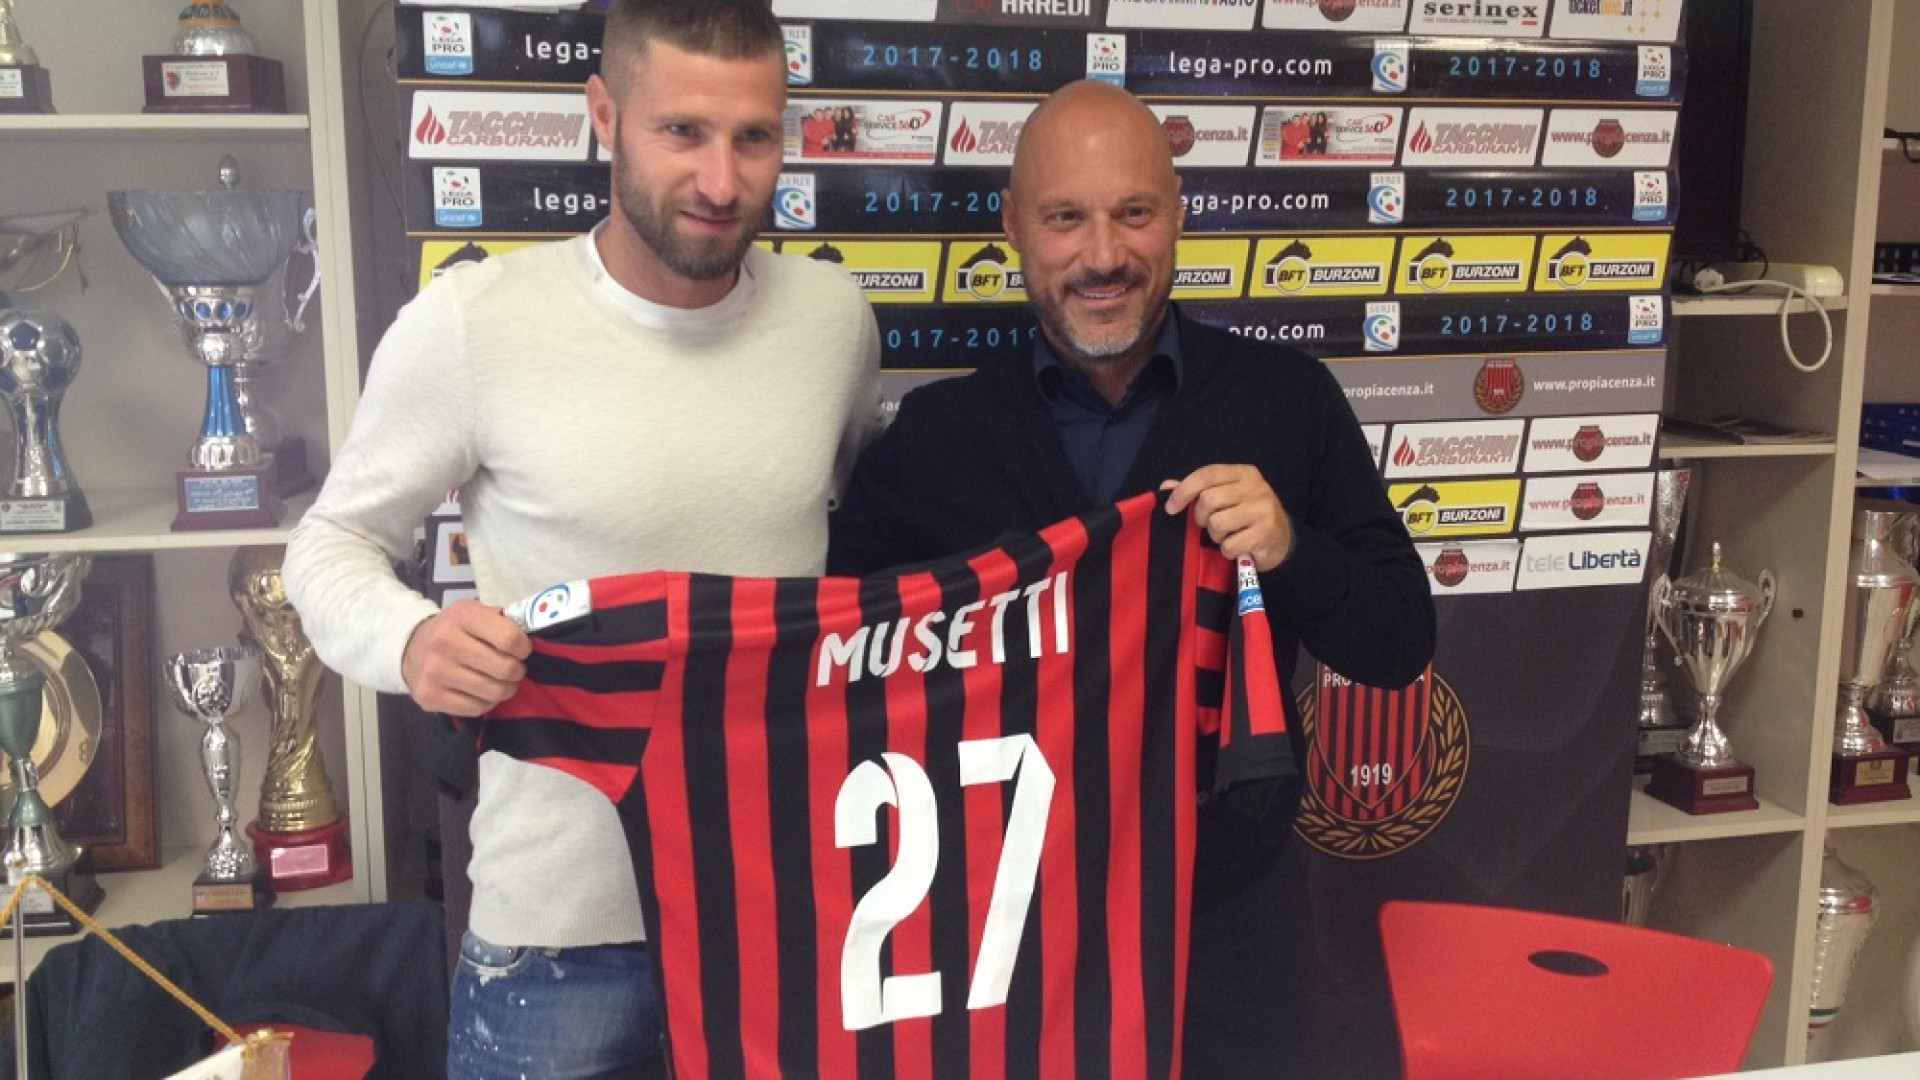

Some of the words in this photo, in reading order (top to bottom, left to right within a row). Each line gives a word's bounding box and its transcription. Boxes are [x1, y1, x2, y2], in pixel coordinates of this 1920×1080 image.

[1001, 0, 1090, 16] ARREDI
[1424, 0, 1539, 18] serinex
[432, 44, 465, 53] PRO
[863, 45, 1042, 71] 2017-2018
[1169, 51, 1332, 78] lega-pro.com
[1449, 55, 1601, 78] 2017-2018
[1643, 71, 1666, 79] PRO
[448, 111, 586, 136] TACCHINI
[446, 134, 579, 149] CARBURANTI
[1433, 124, 1538, 144] TACCHINI
[1431, 141, 1533, 154] CARBURANTI
[441, 197, 476, 207] PRO
[1446, 186, 1598, 207] 2017-2018
[1640, 196, 1663, 204] PRO
[1278, 269, 1305, 282] BFT
[1313, 267, 1376, 282] BURZONI
[1422, 267, 1447, 279] BFT
[1455, 264, 1516, 279] BURZONI
[1561, 264, 1585, 276] BFT
[1592, 263, 1651, 276] BURZONI
[972, 274, 999, 287] BFT
[1441, 313, 1593, 335] 2017-2018
[1533, 374, 1656, 394] www.propiacenza.it
[1417, 435, 1520, 454] TACCHINI
[1414, 451, 1514, 466] CARBURANTI
[1407, 510, 1434, 524] BFT
[1442, 508, 1501, 523] BURZONI
[1526, 553, 1566, 573] tele
[1569, 549, 1641, 571] Libertà
[816, 571, 1068, 687] MUSETTI
[1351, 763, 1393, 786] 1919
[833, 733, 1056, 1030] 27
